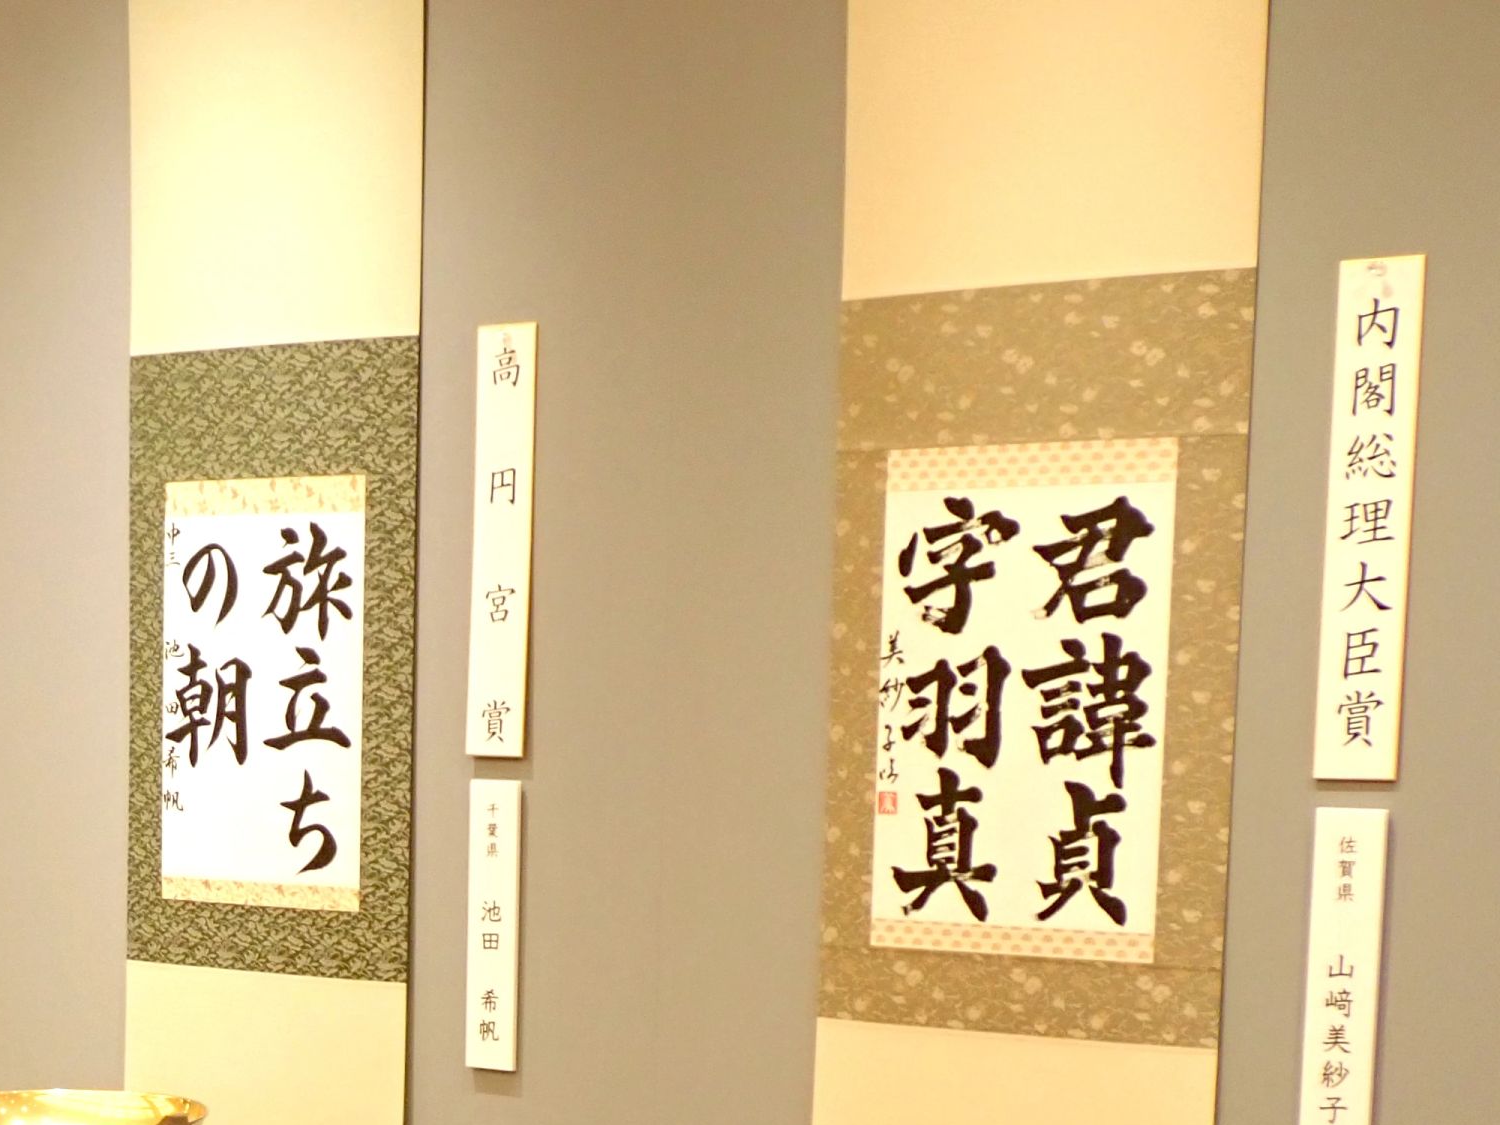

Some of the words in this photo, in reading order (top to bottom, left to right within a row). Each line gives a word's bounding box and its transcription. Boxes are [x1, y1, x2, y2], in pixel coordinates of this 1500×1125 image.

[164, 542, 253, 768] の朝
[166, 522, 181, 566] 中三
[481, 346, 520, 744] 高円宮賞
[1337, 298, 1400, 750] 内閣総理大臣賞
[262, 521, 353, 874] 旅立ち
[487, 803, 498, 857] 千葉県
[1020, 495, 1157, 927] 君諱貞
[1337, 836, 1357, 902] 佐賀県
